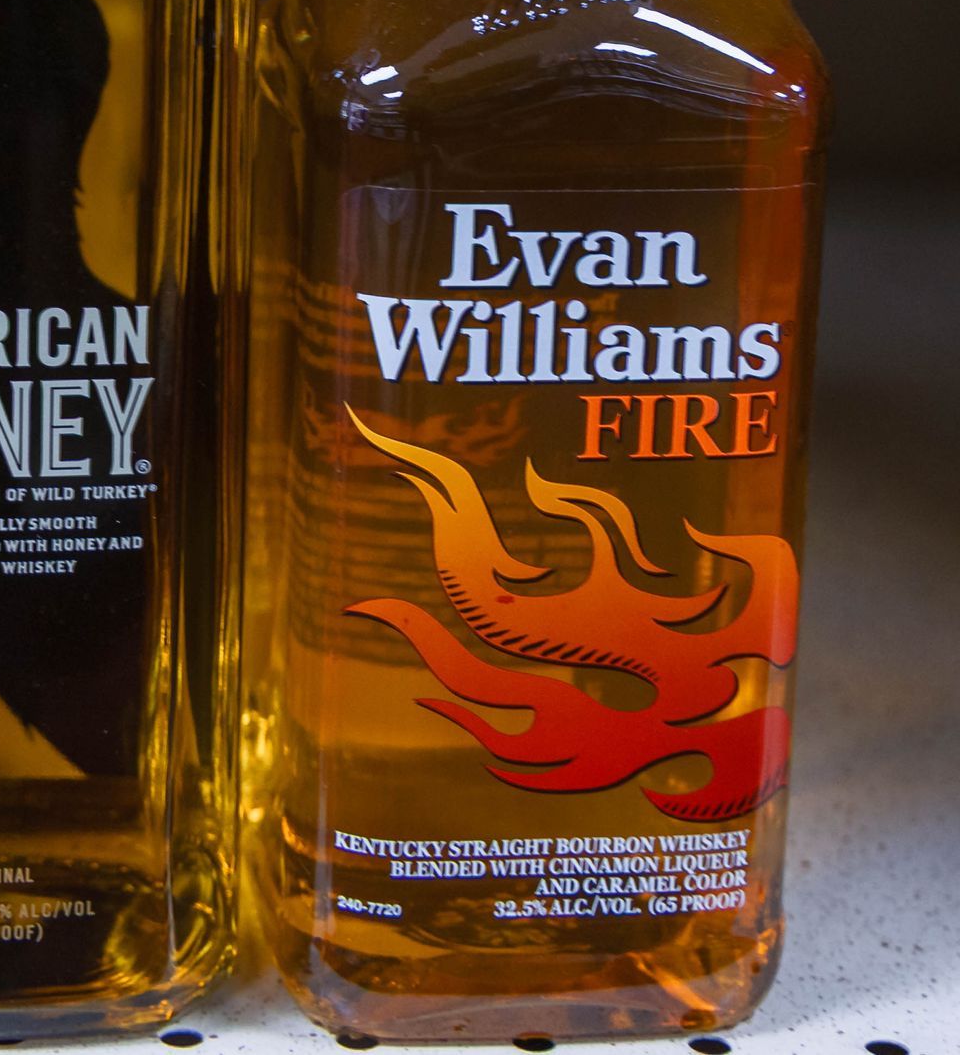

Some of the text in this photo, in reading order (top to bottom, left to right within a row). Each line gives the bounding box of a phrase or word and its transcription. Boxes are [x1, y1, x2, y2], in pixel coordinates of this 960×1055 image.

[439, 202, 708, 288] Evan
[356, 292, 781, 384] Williams
[576, 390, 779, 461] FIRE
[5, 488, 27, 501] OF
[31, 487, 76, 501] WILD
[28, 516, 98, 531] SMOOTH
[3, 539, 47, 553] WITH
[51, 537, 106, 552] HONEY
[107, 536, 144, 550] AND
[1, 559, 78, 575] WHISKEY
[333, 829, 751, 859] KENTUCKY STRAIGHT BOURBON WHISKEY
[390, 850, 749, 878] BLENDED WITH CINNAMON LIQUEUR
[534, 869, 747, 896] AND CARAMEL COLOR
[18, 900, 96, 918] ALC/VOL
[336, 895, 404, 917] 240-7720
[493, 900, 547, 918] 32.5%
[647, 896, 678, 915] (65
[679, 889, 746, 913] PROOF)
